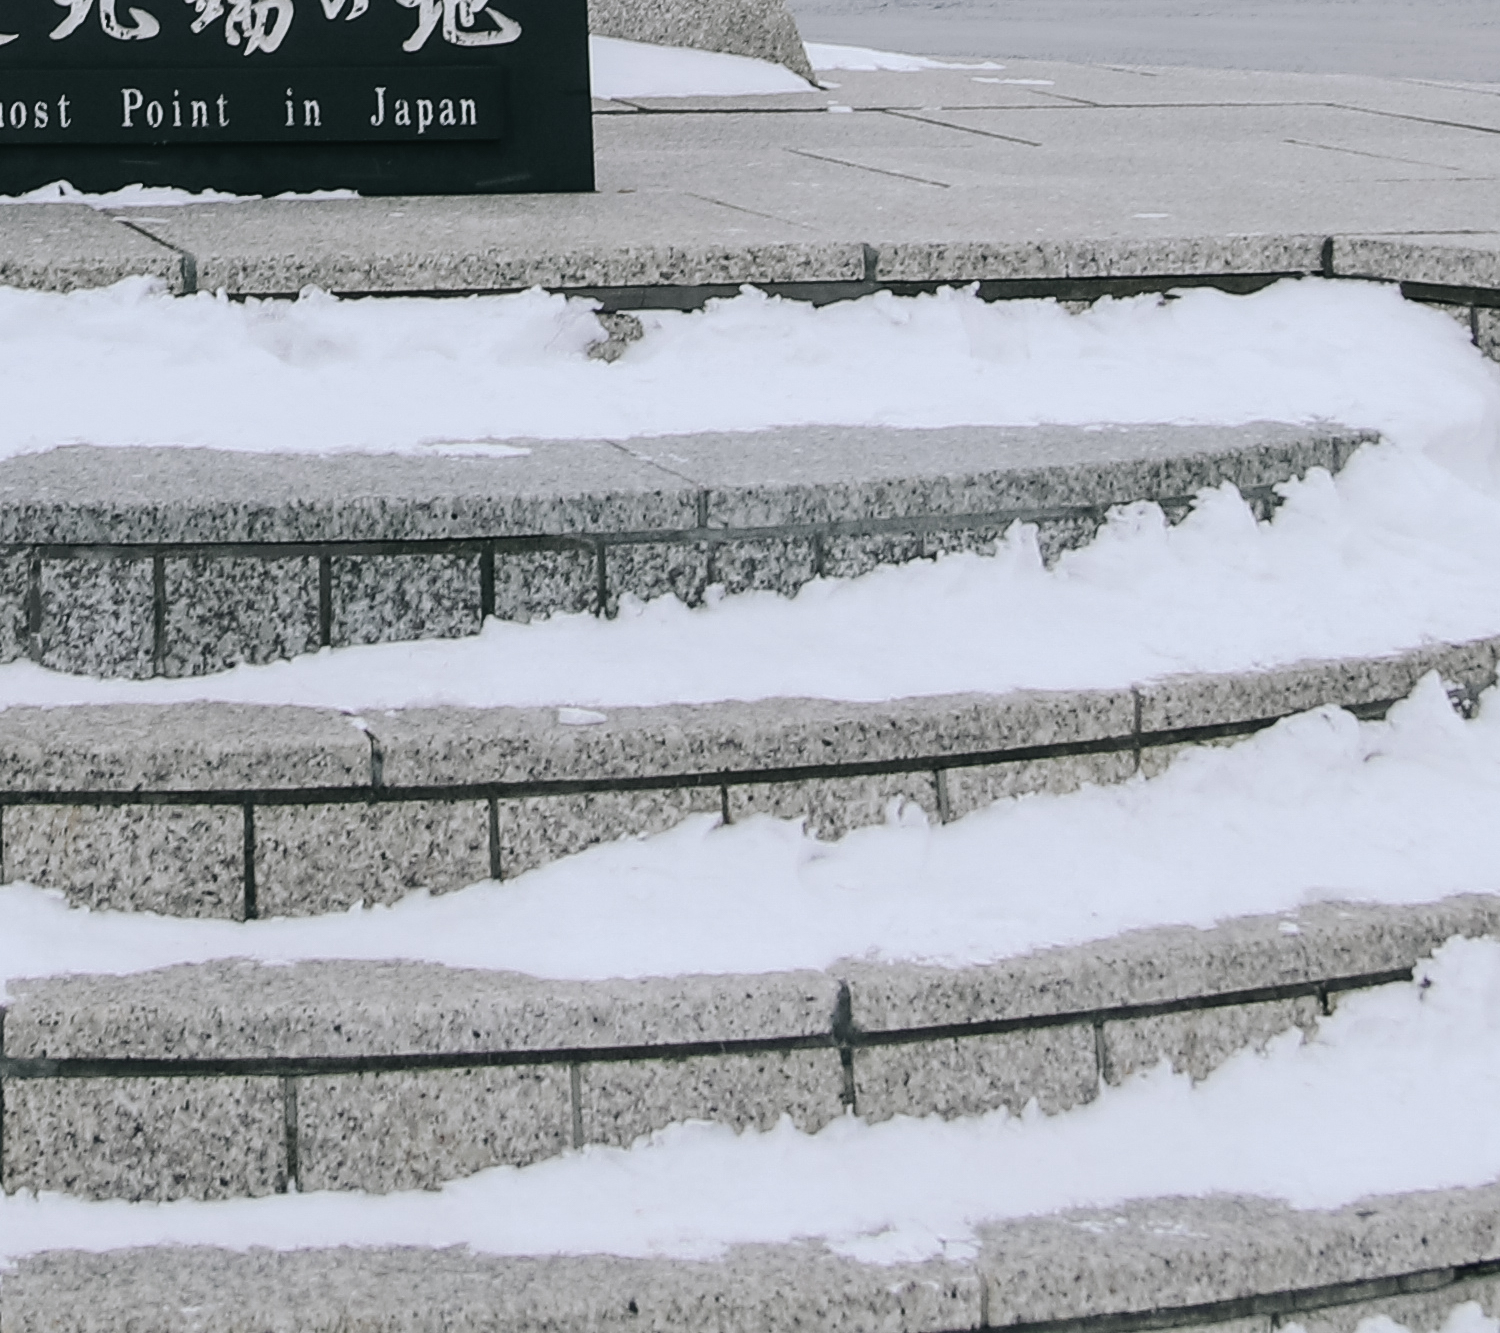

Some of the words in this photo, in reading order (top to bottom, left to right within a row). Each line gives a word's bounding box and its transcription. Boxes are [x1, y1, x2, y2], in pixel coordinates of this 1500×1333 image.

[120, 88, 230, 128] Point
[285, 87, 322, 127] in
[370, 86, 477, 135] Japan
